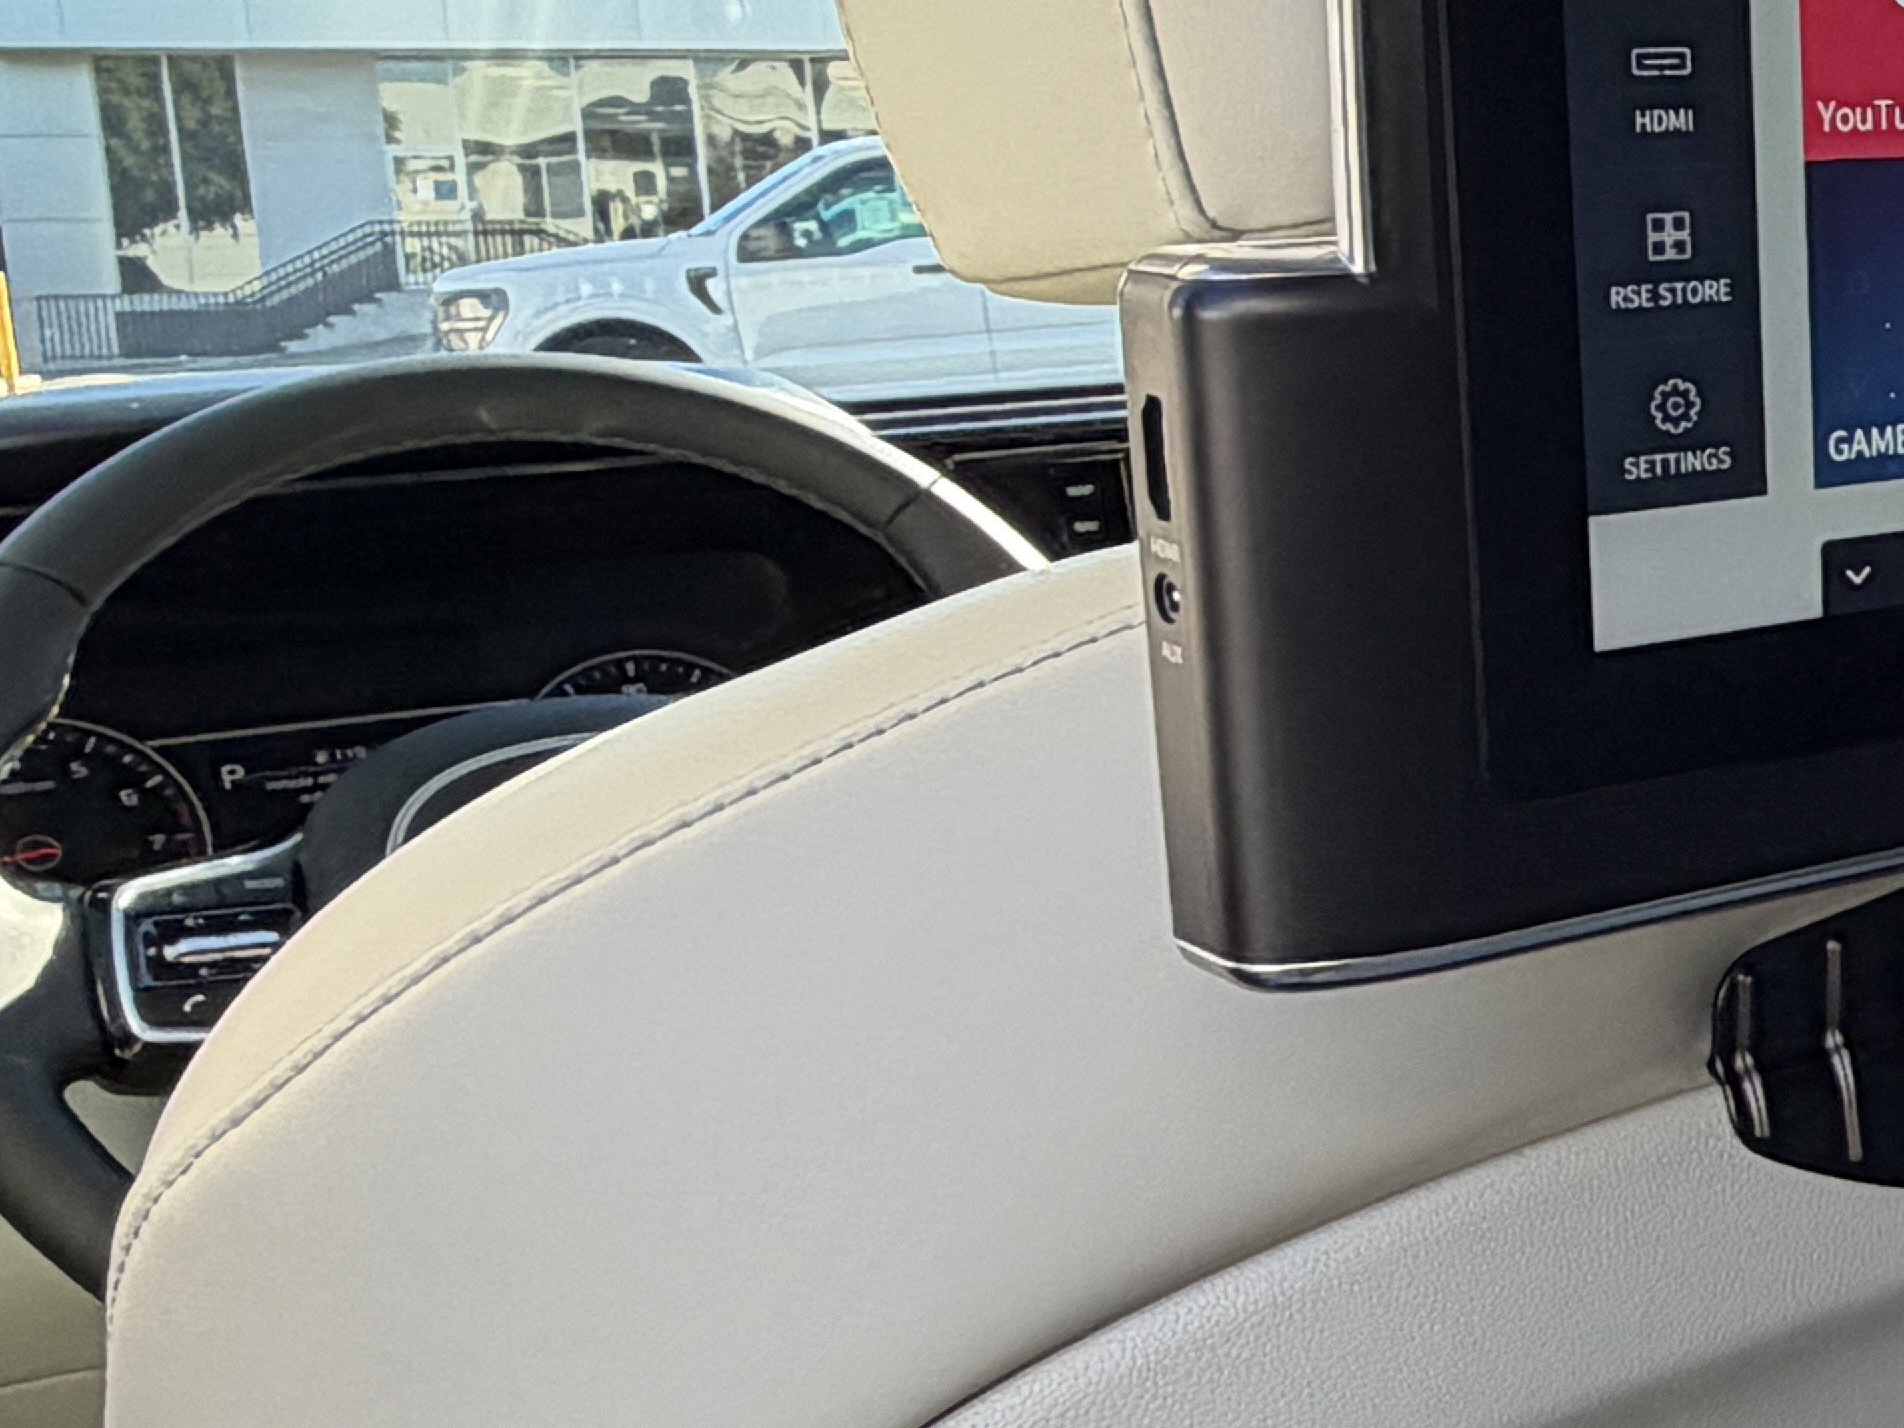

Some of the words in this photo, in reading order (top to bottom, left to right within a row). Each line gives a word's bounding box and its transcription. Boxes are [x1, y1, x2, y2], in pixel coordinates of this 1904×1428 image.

[1633, 107, 1694, 133] HDMI
[1609, 282, 1655, 310] RSE
[1657, 277, 1733, 306] STORE
[1623, 445, 1732, 480] SETTINGS
[219, 762, 246, 791] P
